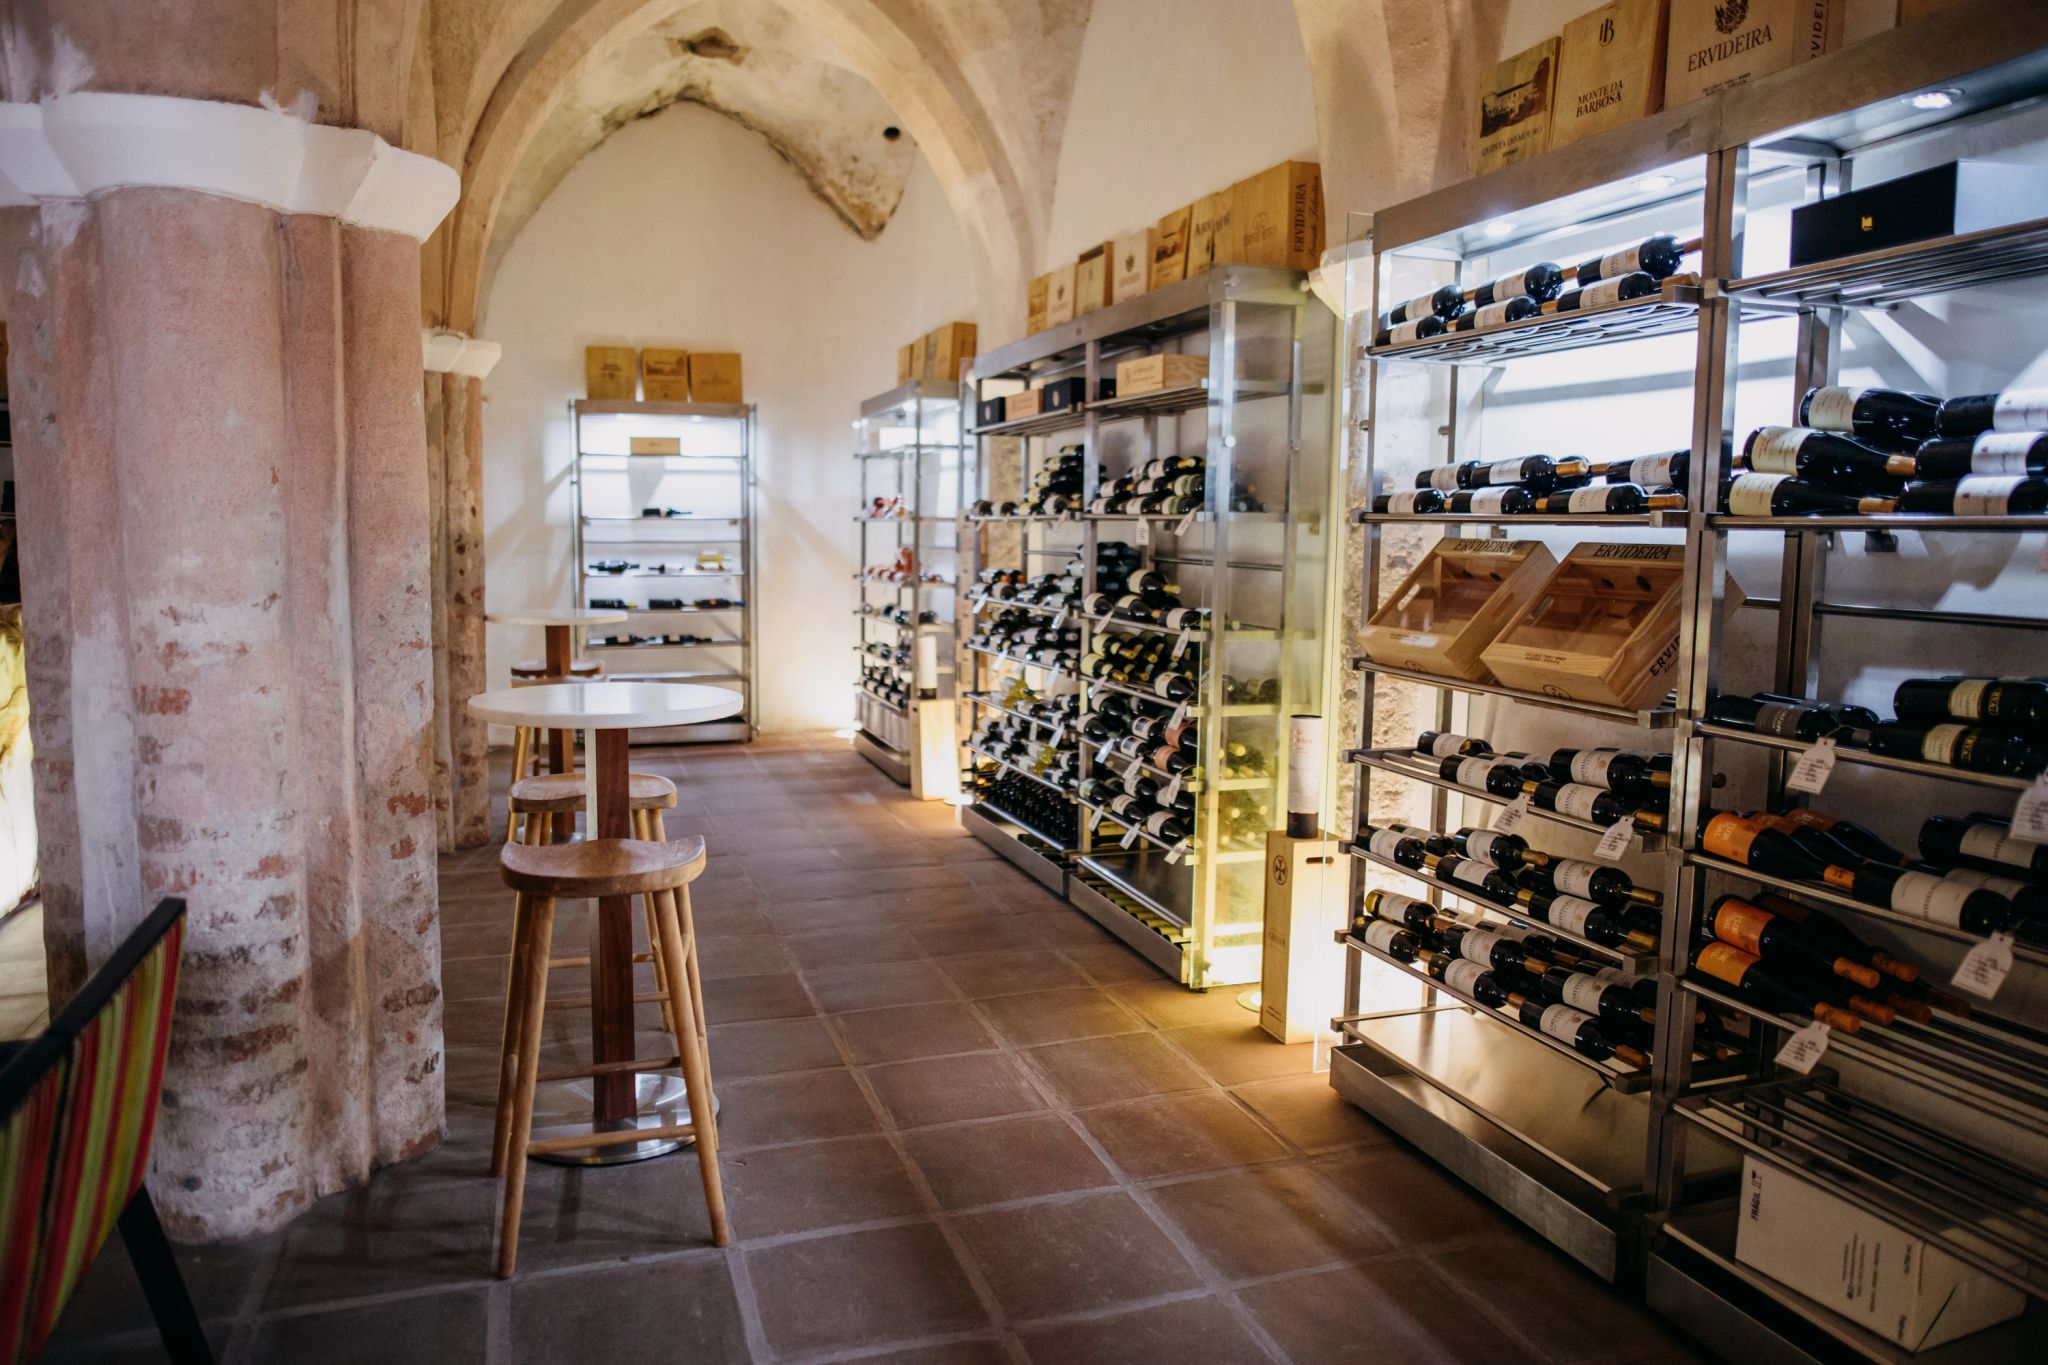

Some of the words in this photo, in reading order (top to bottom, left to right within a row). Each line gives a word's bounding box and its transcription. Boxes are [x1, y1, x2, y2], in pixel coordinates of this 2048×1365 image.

[1687, 24, 1773, 73] ERVIDEIRA
[1576, 91, 1622, 118] BARBOSA
[1577, 83, 1610, 105] MONTE
[1610, 79, 1623, 93] DA
[1293, 183, 1306, 253] ERVIDEIRA
[1454, 540, 1514, 553] ERVIDEIRA
[1592, 544, 1673, 560] ERVIDEIRA
